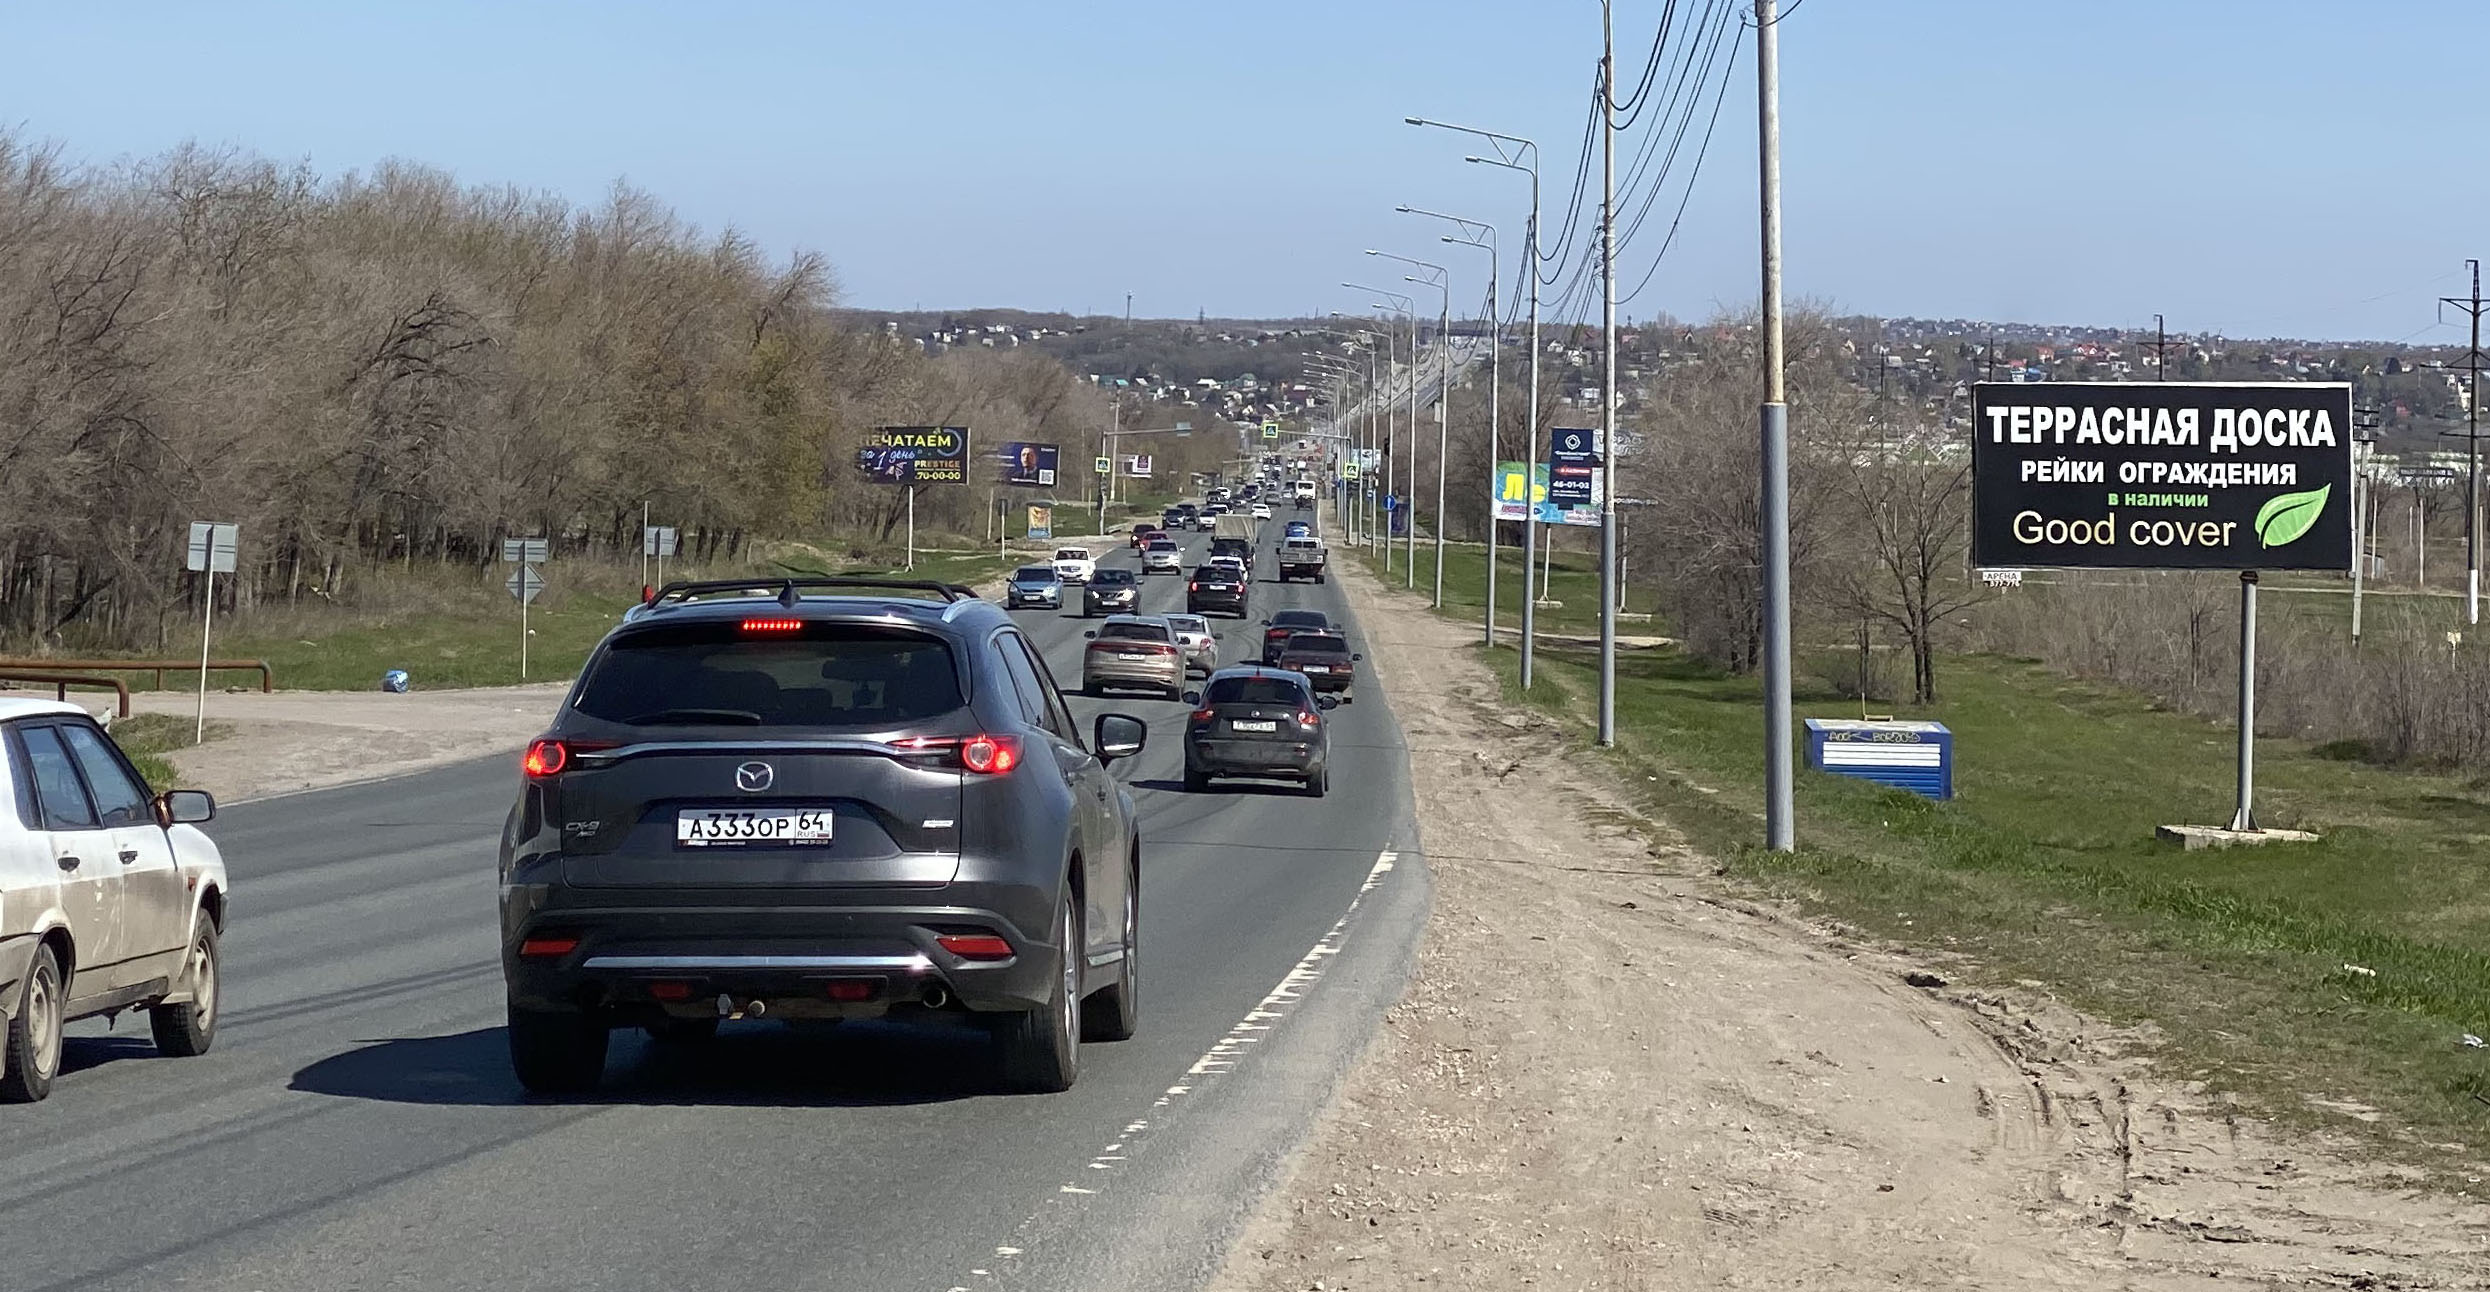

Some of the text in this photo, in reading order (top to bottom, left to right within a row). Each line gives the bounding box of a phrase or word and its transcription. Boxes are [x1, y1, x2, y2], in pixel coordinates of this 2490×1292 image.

[1986, 406, 2337, 453] ТЕРРАСНАЯ ДОСКА
[873, 451, 887, 470] 1
[889, 450, 916, 463] день
[914, 460, 961, 468] PRESTIGE
[2021, 456, 2297, 488] РЕЙКИ ОГРАЖДЕНИЯ
[2108, 493, 2208, 507] в наличии
[2013, 510, 2237, 547] Good cover
[1986, 572, 2018, 580] АРЕНА
[798, 811, 824, 831] 64
[797, 830, 816, 838] RUS
